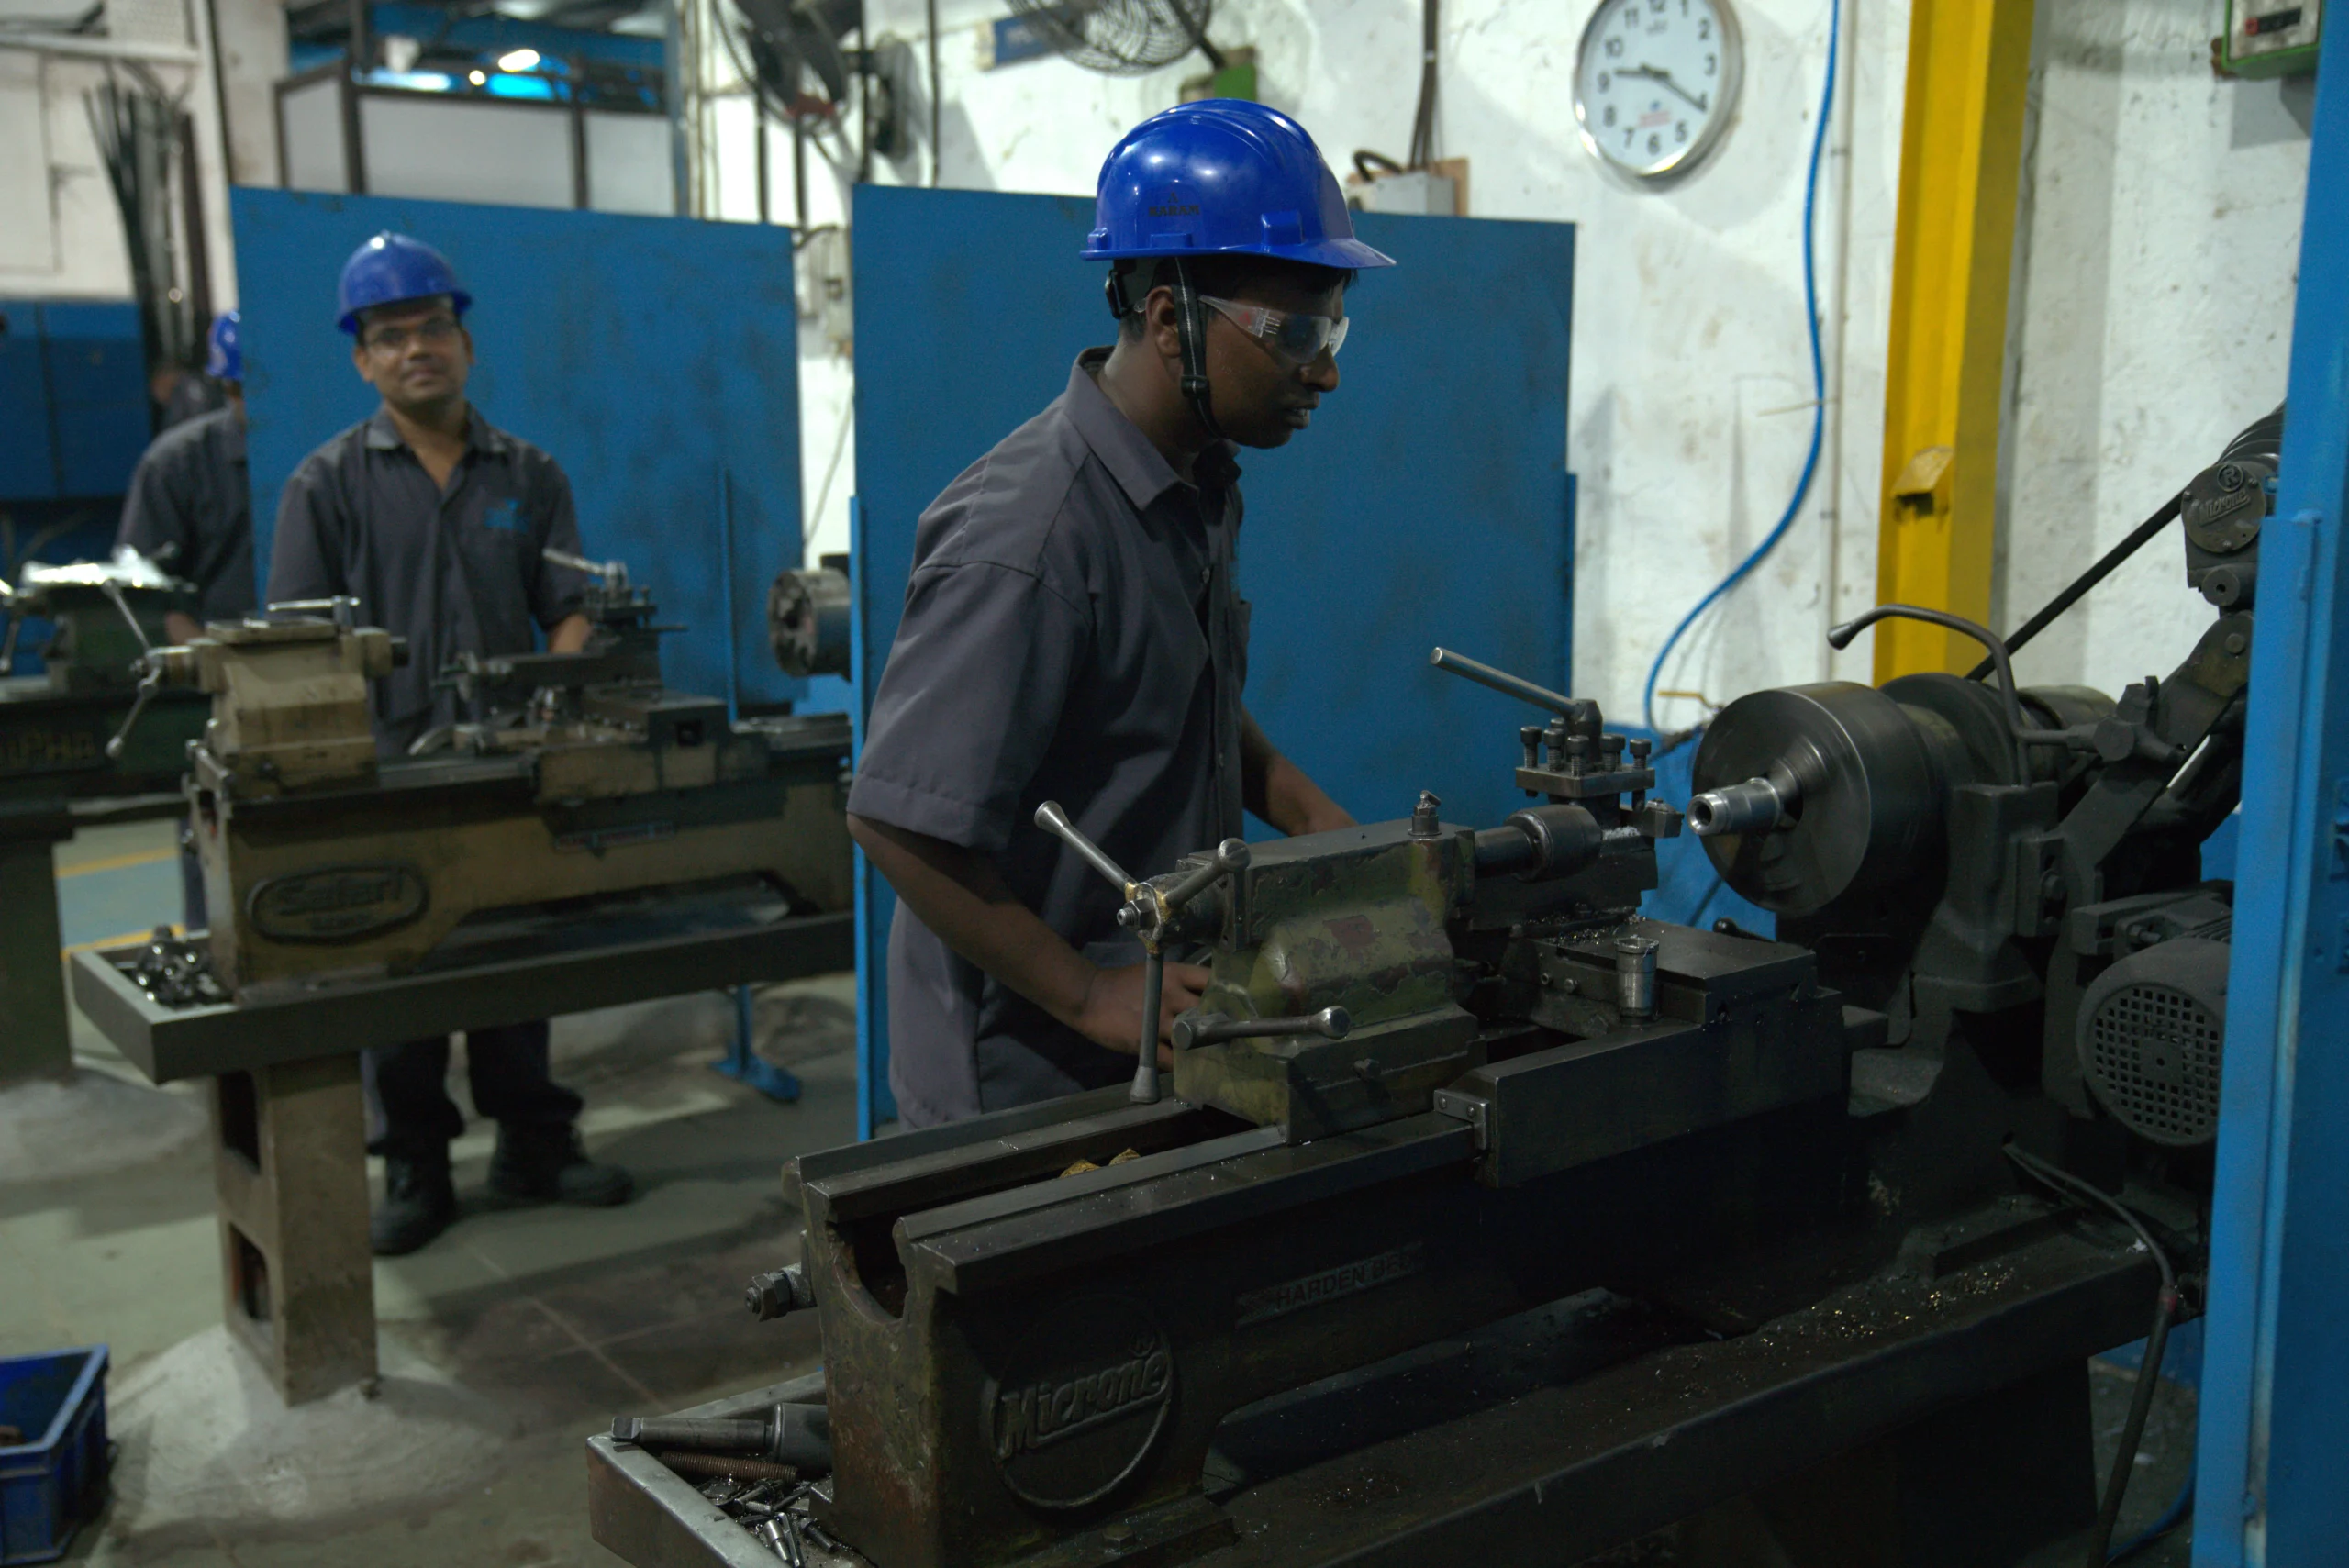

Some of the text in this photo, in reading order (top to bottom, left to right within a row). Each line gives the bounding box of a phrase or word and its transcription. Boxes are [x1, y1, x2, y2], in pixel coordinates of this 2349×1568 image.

[1624, 7, 1640, 28] 11
[1699, 17, 1710, 40] 2
[1605, 36, 1623, 58] 10
[1704, 51, 1717, 76] 3
[1598, 71, 1609, 93] 9
[1604, 104, 1617, 128] 8
[1624, 126, 1634, 149] 7
[1676, 119, 1687, 143] 5
[1648, 132, 1660, 155] 6
[1149, 205, 1199, 217] KARAM
[1276, 1263, 1366, 1309] HARDEN
